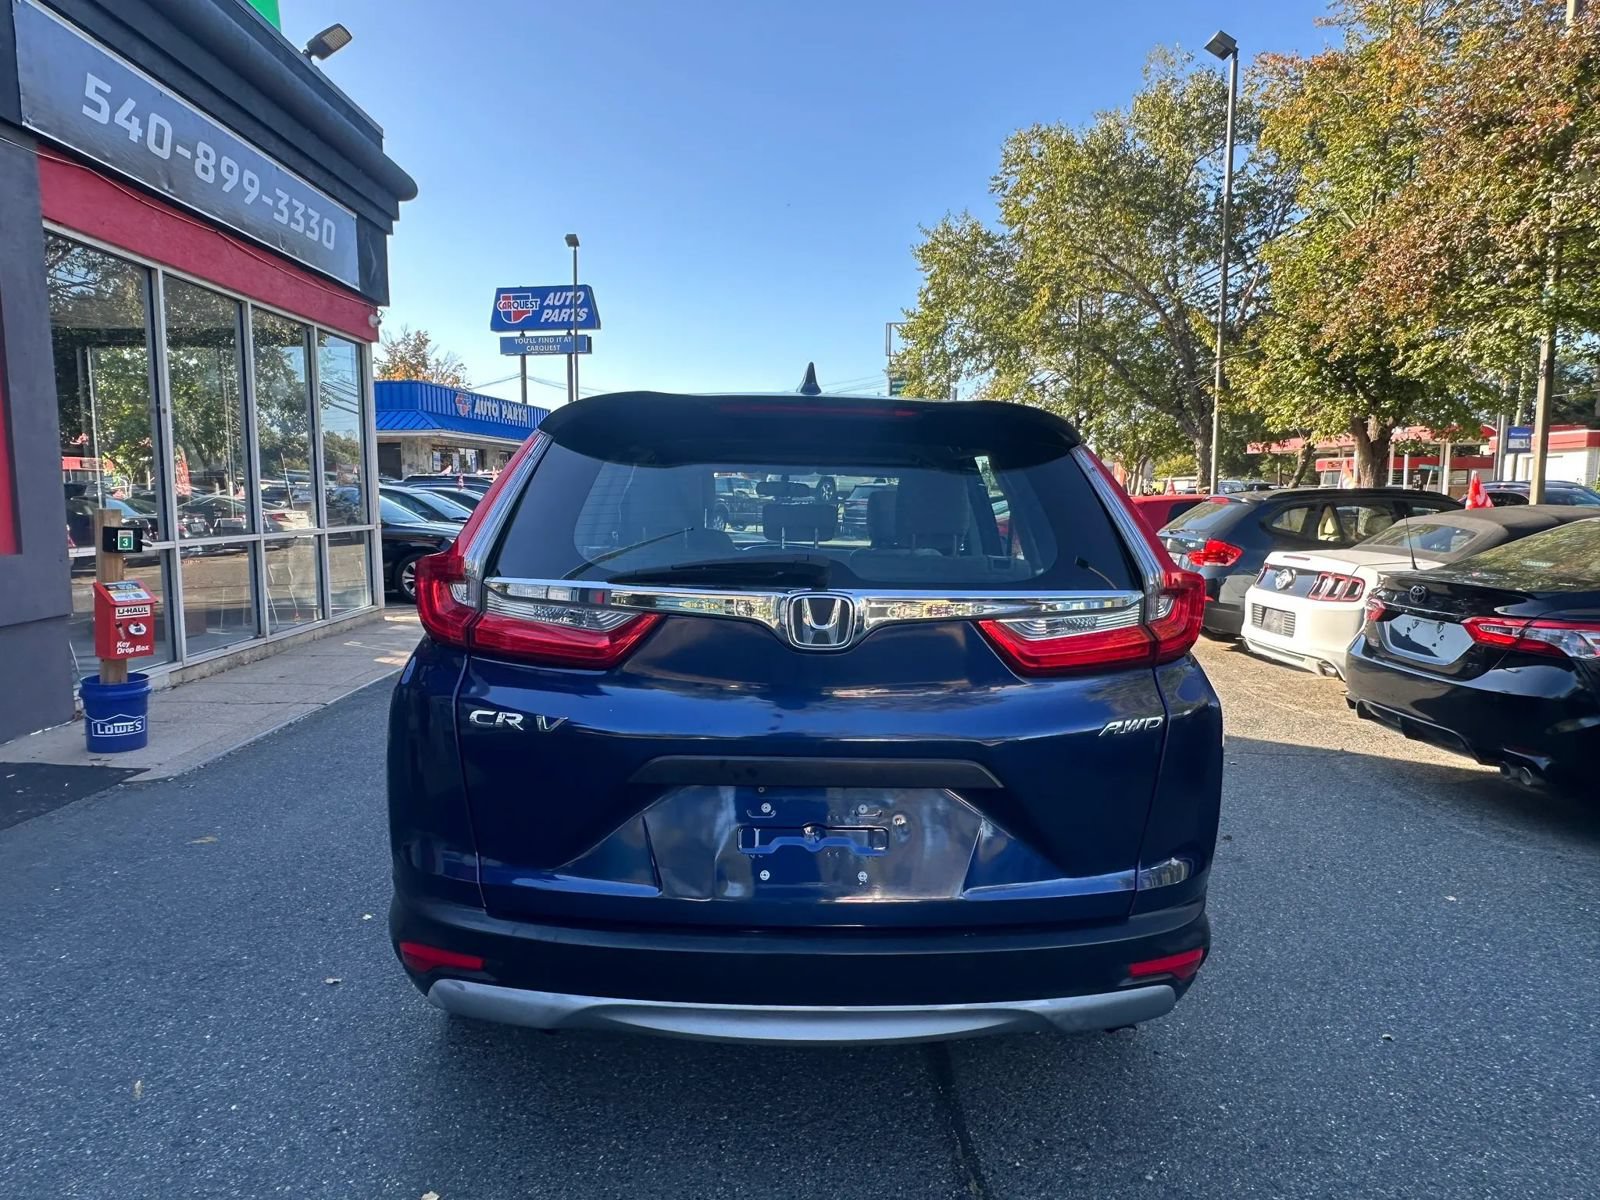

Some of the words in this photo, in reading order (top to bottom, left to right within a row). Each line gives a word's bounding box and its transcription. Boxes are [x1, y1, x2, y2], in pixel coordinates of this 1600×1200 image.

[82, 72, 336, 251] 540-899-3330
[498, 300, 539, 310] CARQUEST
[538, 336, 555, 344] FIND
[474, 399, 500, 418] AUTO
[501, 403, 528, 423] PARTS
[122, 538, 129, 547] 3
[117, 607, 148, 615] U-HAUL
[116, 641, 131, 649] Key
[116, 647, 135, 655] Drop
[1098, 716, 1163, 737] AWD
